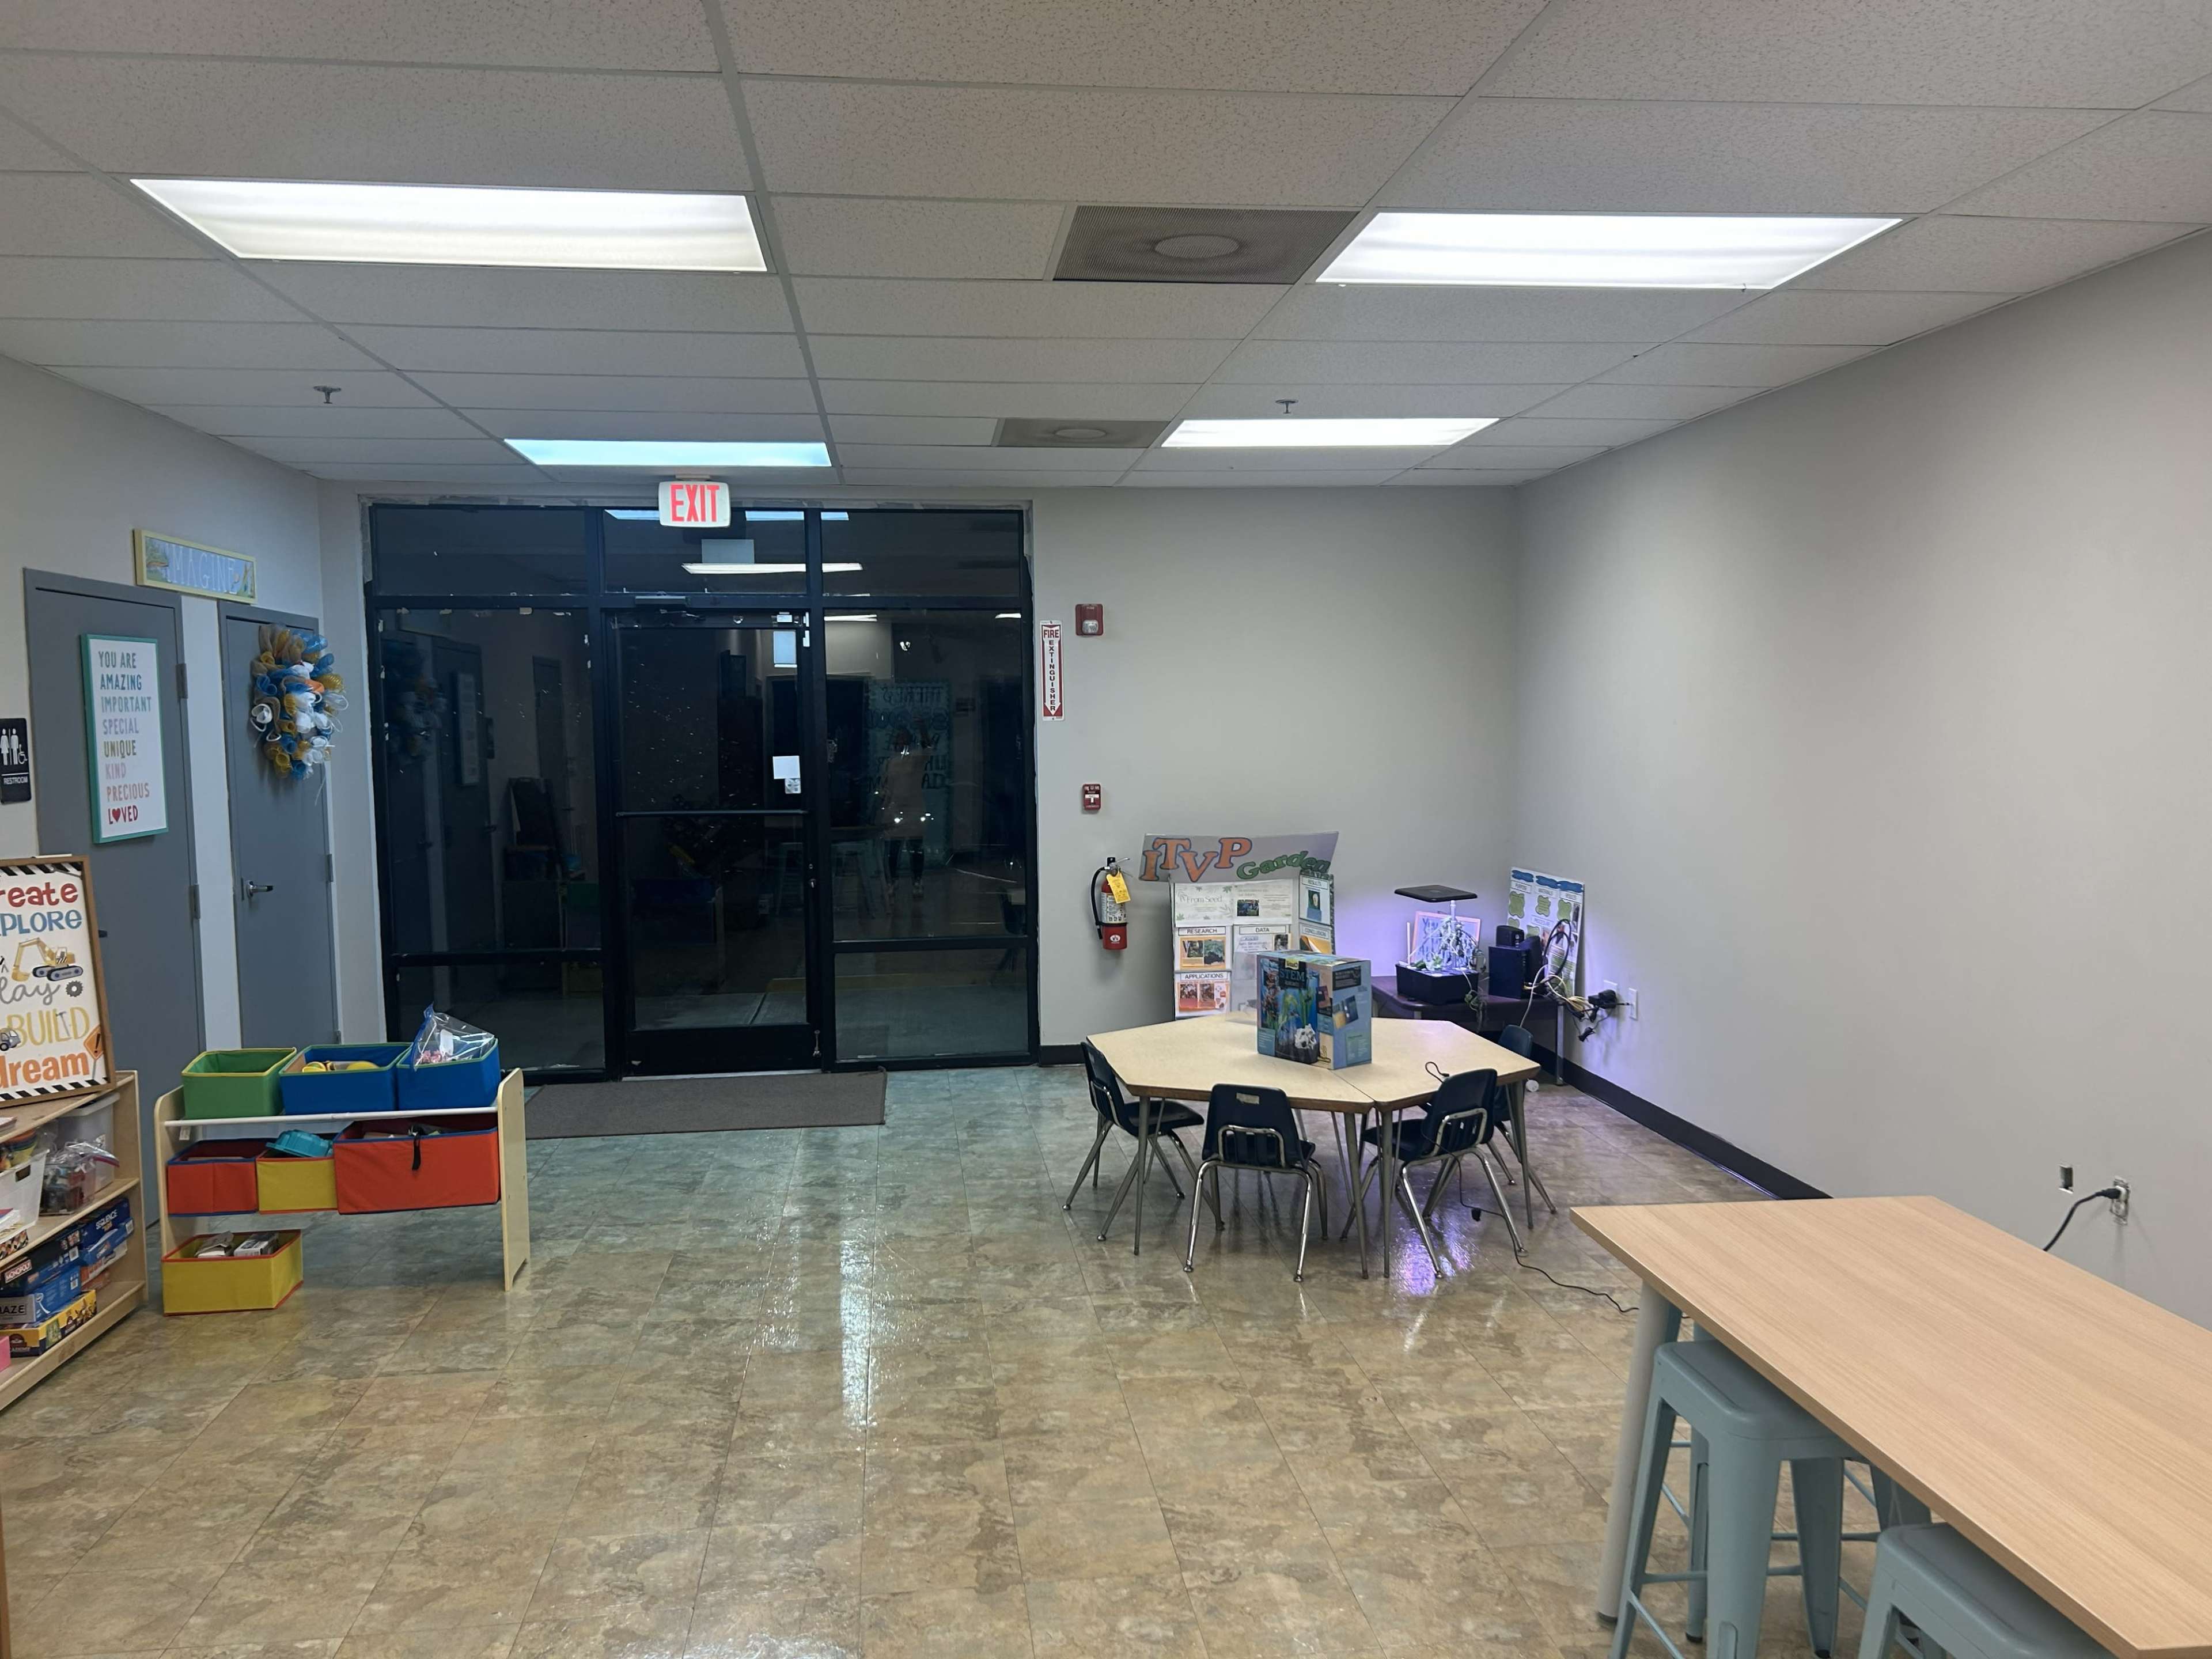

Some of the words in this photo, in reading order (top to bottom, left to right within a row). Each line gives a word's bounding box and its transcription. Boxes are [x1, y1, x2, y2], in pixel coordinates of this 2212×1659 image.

[671, 484, 719, 522] EXIT
[166, 543, 237, 594] IMAGINE
[1044, 630, 1059, 638] FIRE
[98, 652, 116, 668] YOU
[120, 653, 137, 668] ARE
[100, 674, 142, 690] AMAZING
[101, 696, 151, 713] IMPORTANT
[103, 718, 139, 734] SPECIAL
[104, 740, 137, 758] UNIQUE
[105, 763, 126, 780] KIND
[3, 776, 28, 785] RESTROOM
[107, 783, 150, 802] PRECIOUS
[1236, 851, 1330, 880] Garden
[0, 882, 79, 908] eate
[1280, 969, 1305, 982] STEM
[6, 1007, 90, 1048] BUILD
